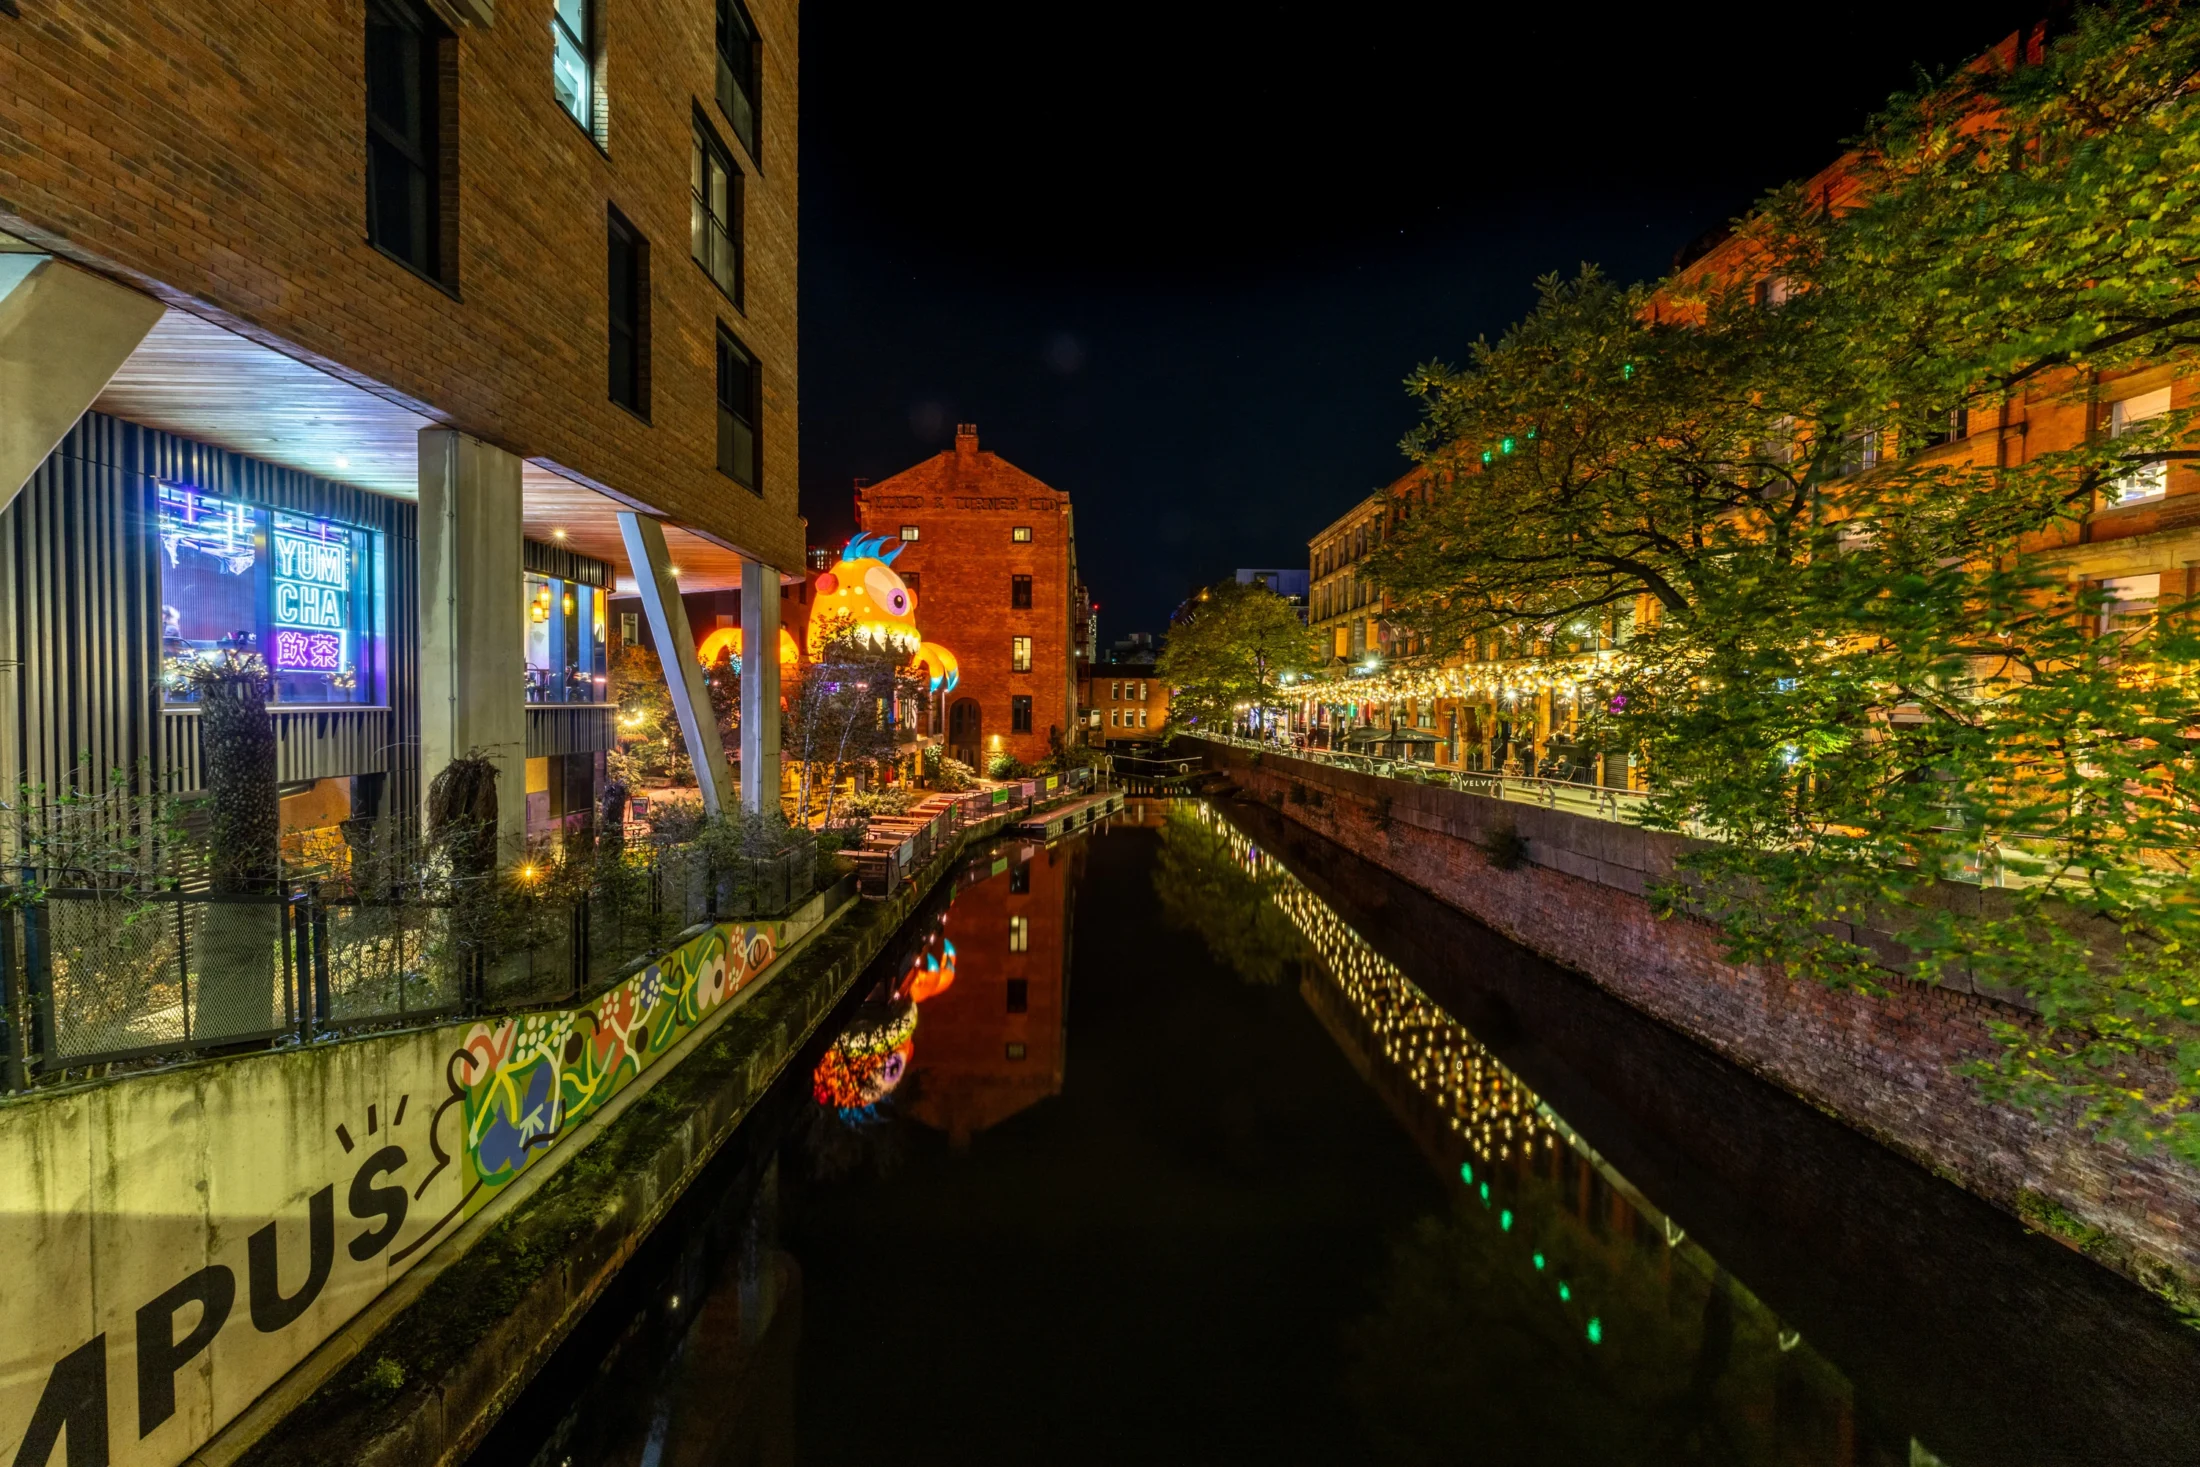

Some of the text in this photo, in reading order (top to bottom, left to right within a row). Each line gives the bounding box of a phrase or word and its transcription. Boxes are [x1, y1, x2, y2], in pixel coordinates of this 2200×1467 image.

[953, 496, 1018, 510] TURNER
[1028, 497, 1059, 510] LTD
[276, 537, 342, 584] YUM
[276, 583, 341, 627] CHA
[277, 631, 339, 668] 飲茶
